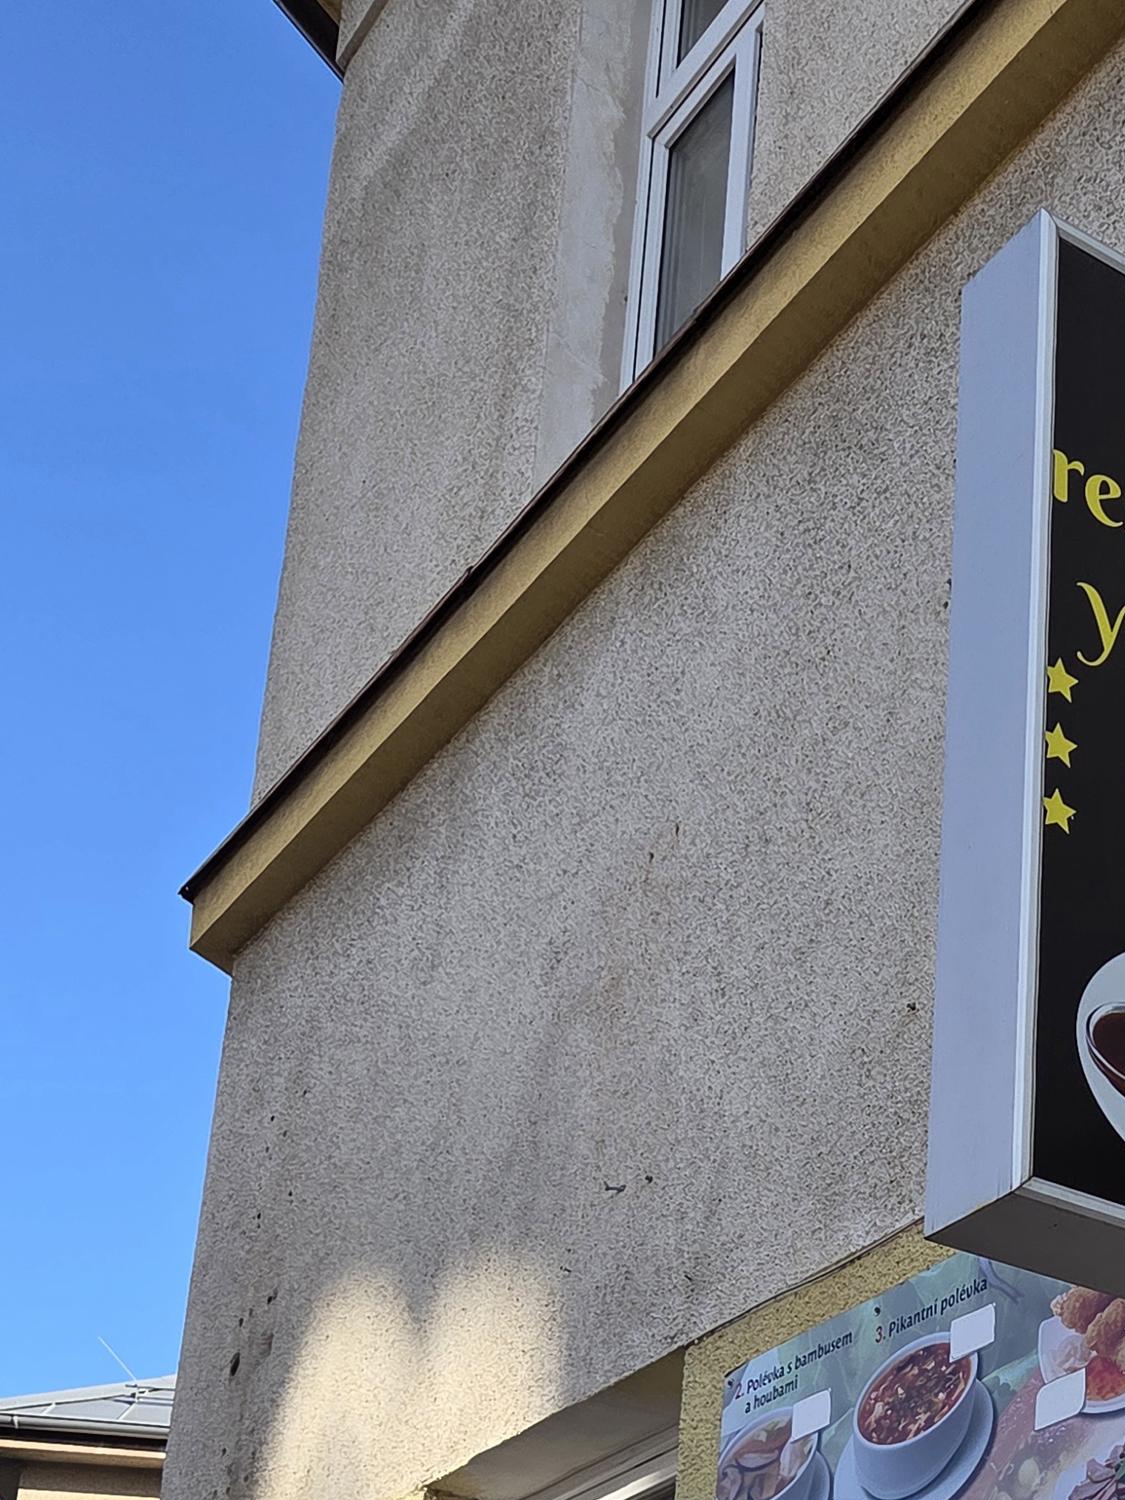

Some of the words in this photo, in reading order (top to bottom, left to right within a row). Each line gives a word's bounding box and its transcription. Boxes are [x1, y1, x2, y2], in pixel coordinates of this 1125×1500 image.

[875, 1326, 885, 1343] 3.
[889, 1298, 938, 1337] Pikantní
[940, 1278, 987, 1315] polévka
[745, 1401, 751, 1414] a
[753, 1374, 798, 1410] houbami
[746, 1365, 785, 1394] Polévka
[787, 1361, 793, 1375] s
[794, 1331, 853, 1370] bambusem
